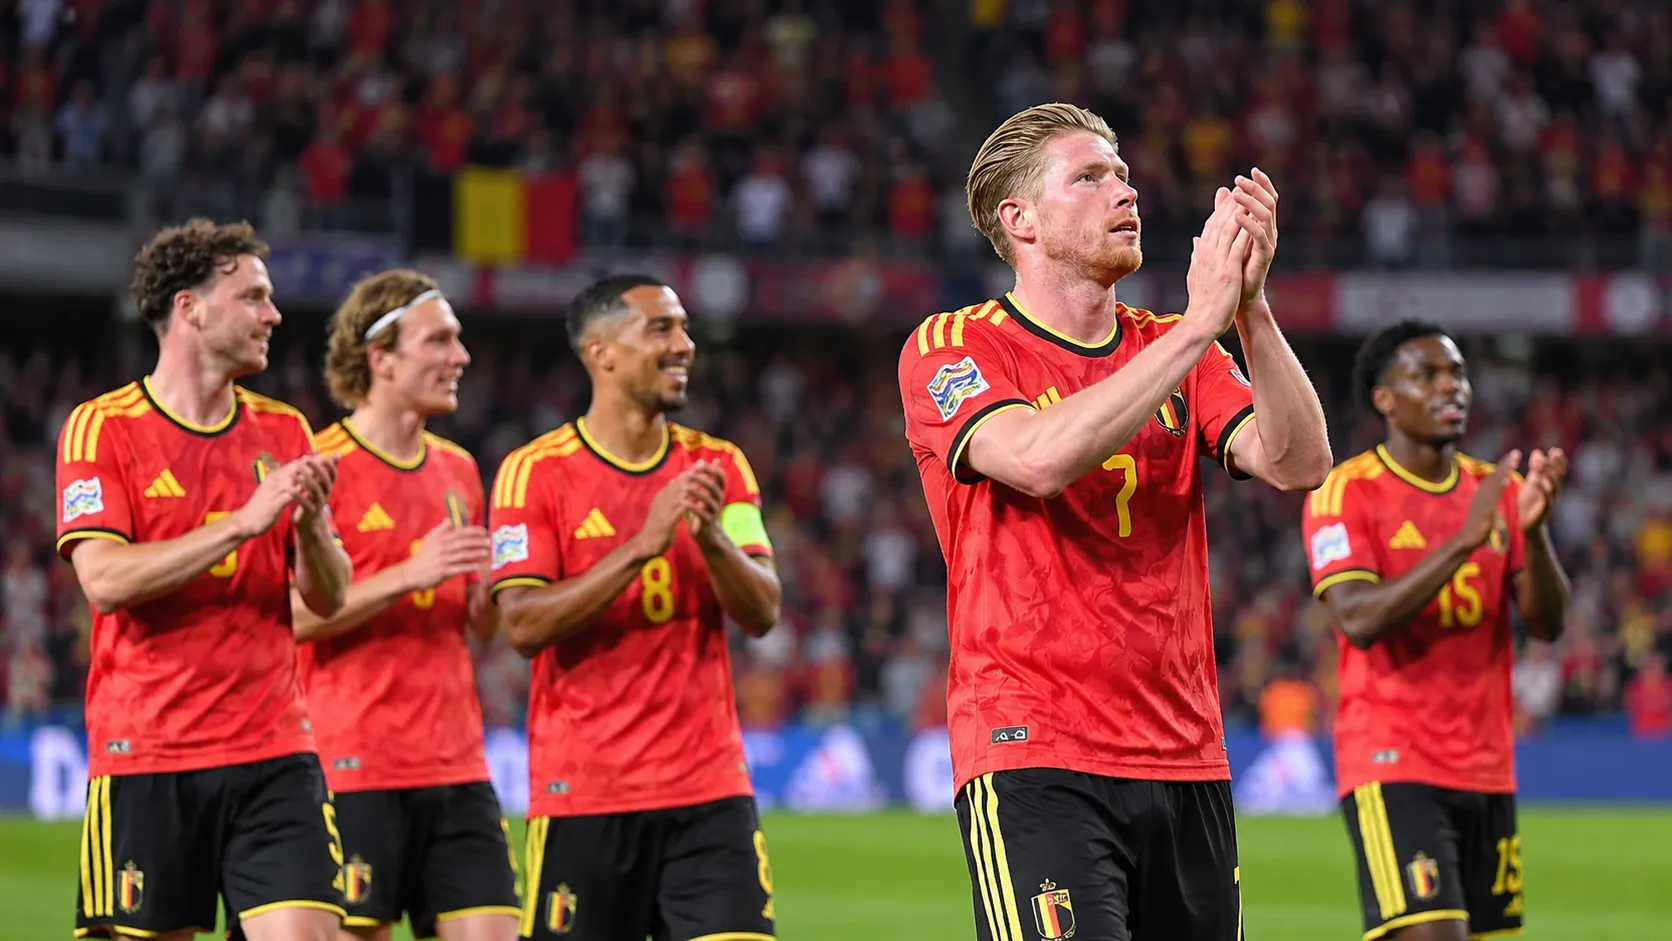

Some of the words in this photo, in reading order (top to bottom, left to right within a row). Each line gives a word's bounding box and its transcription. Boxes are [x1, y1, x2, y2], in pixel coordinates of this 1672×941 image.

[1102, 454, 1137, 537] 7
[641, 556, 674, 624] 8
[1438, 562, 1482, 628] 15
[322, 802, 344, 868] 5
